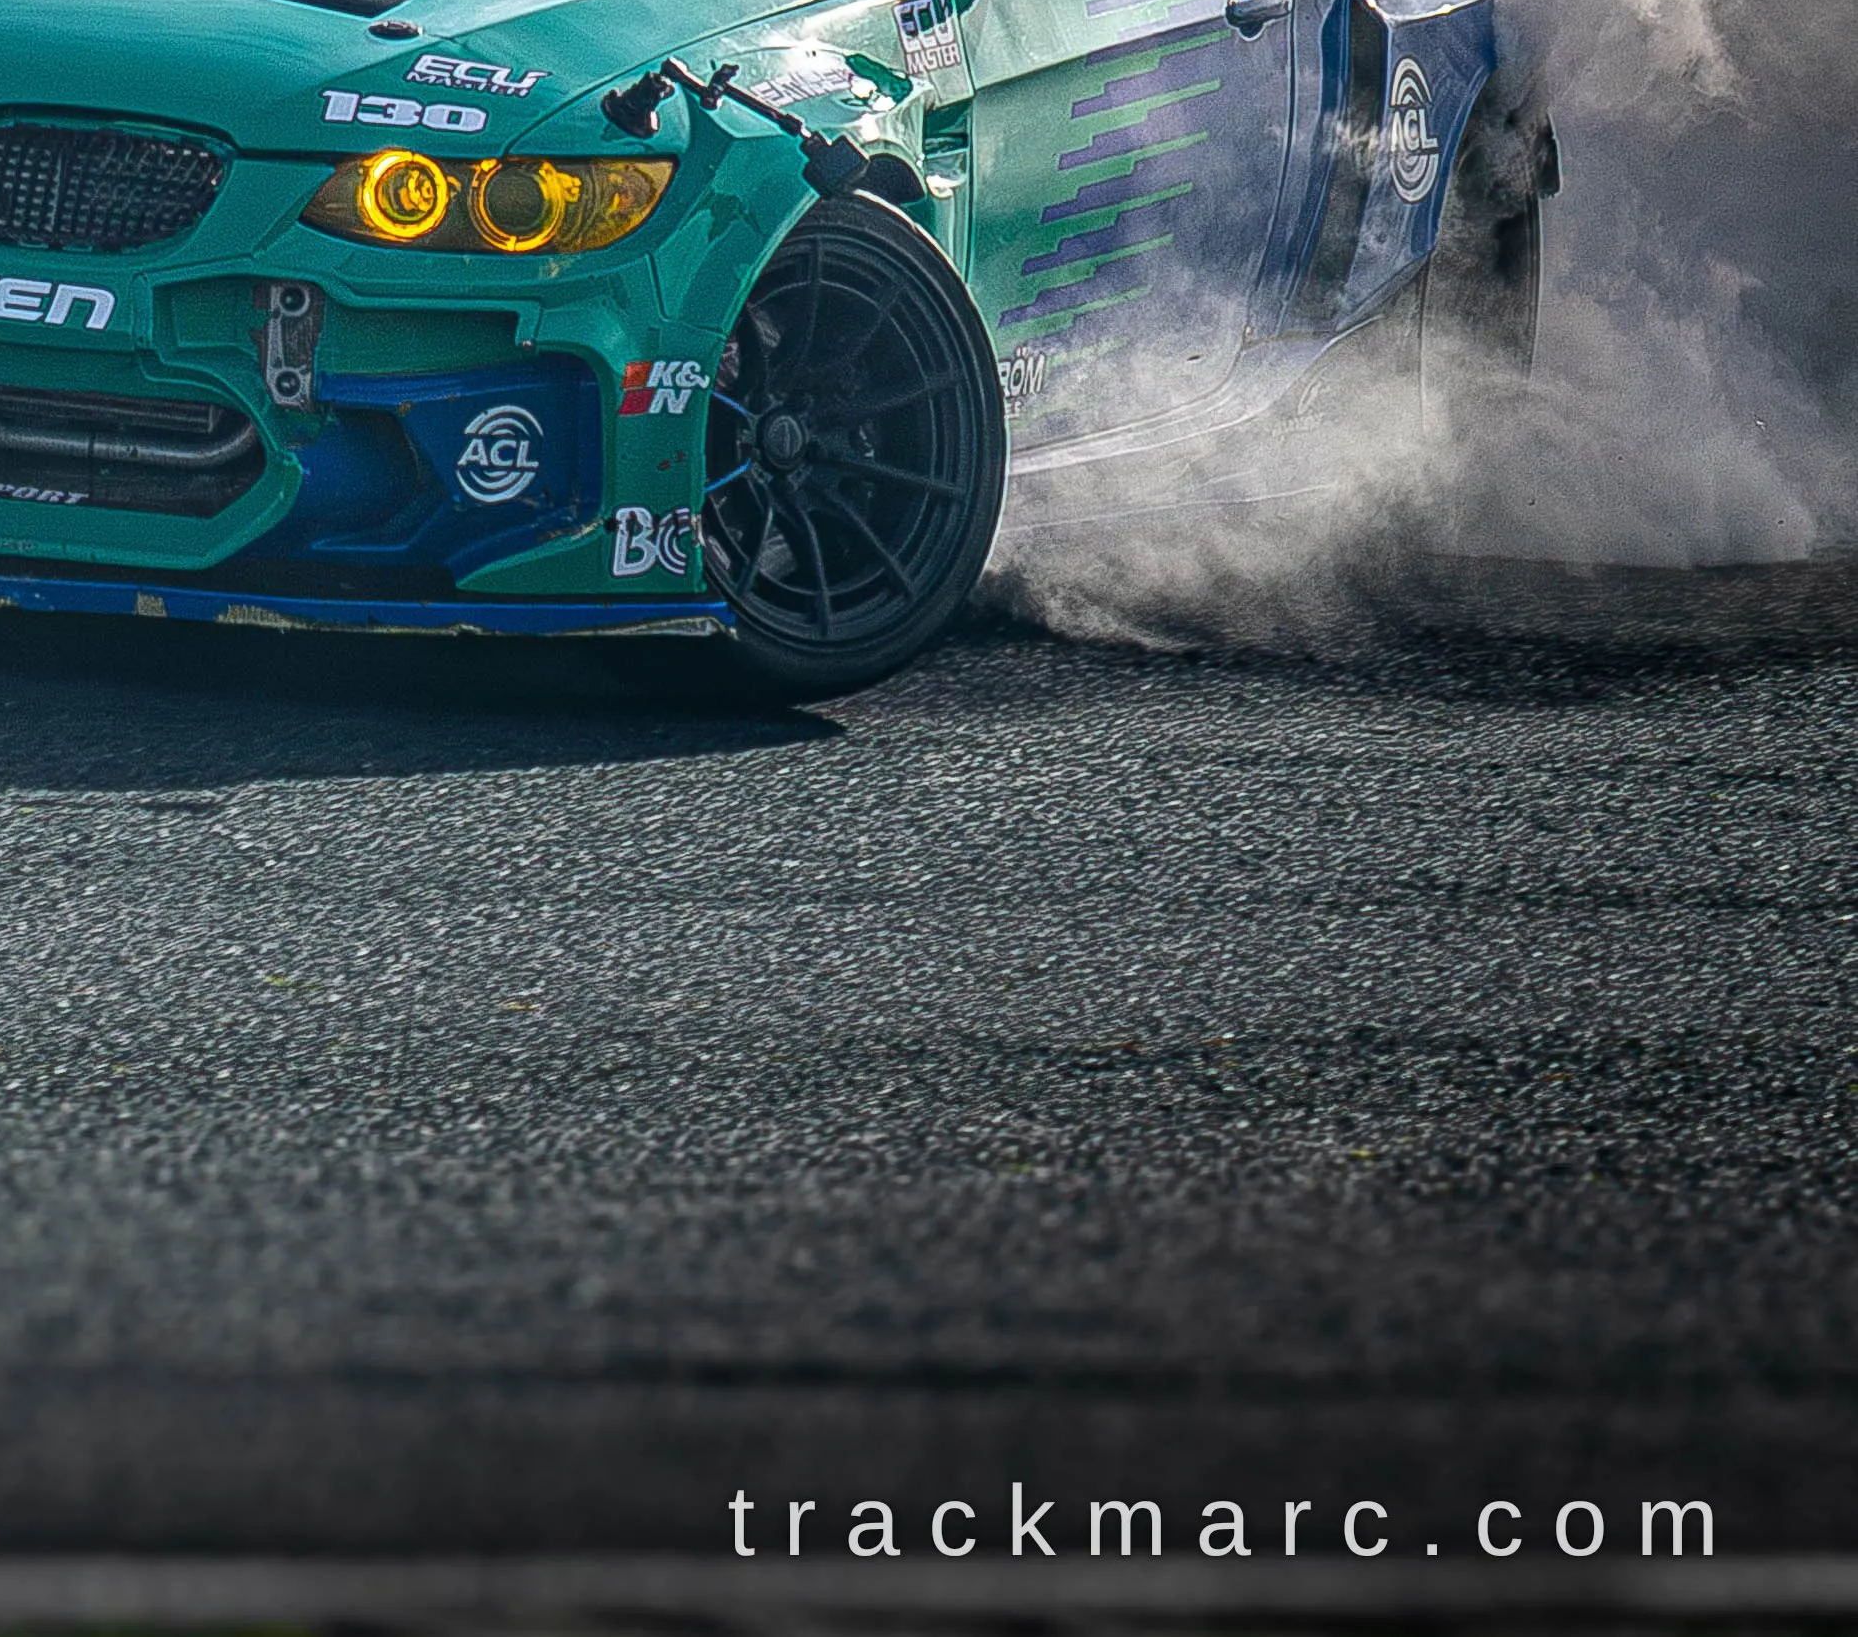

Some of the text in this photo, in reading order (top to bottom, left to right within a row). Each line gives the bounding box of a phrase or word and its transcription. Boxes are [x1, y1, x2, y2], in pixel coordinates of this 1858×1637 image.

[413, 54, 551, 89] ECU
[906, 43, 961, 76] MASTER
[321, 90, 488, 132] 130
[1389, 108, 1439, 153] ACL
[646, 361, 711, 389] K&
[997, 346, 1046, 397] RÖM
[457, 438, 540, 469] ACL
